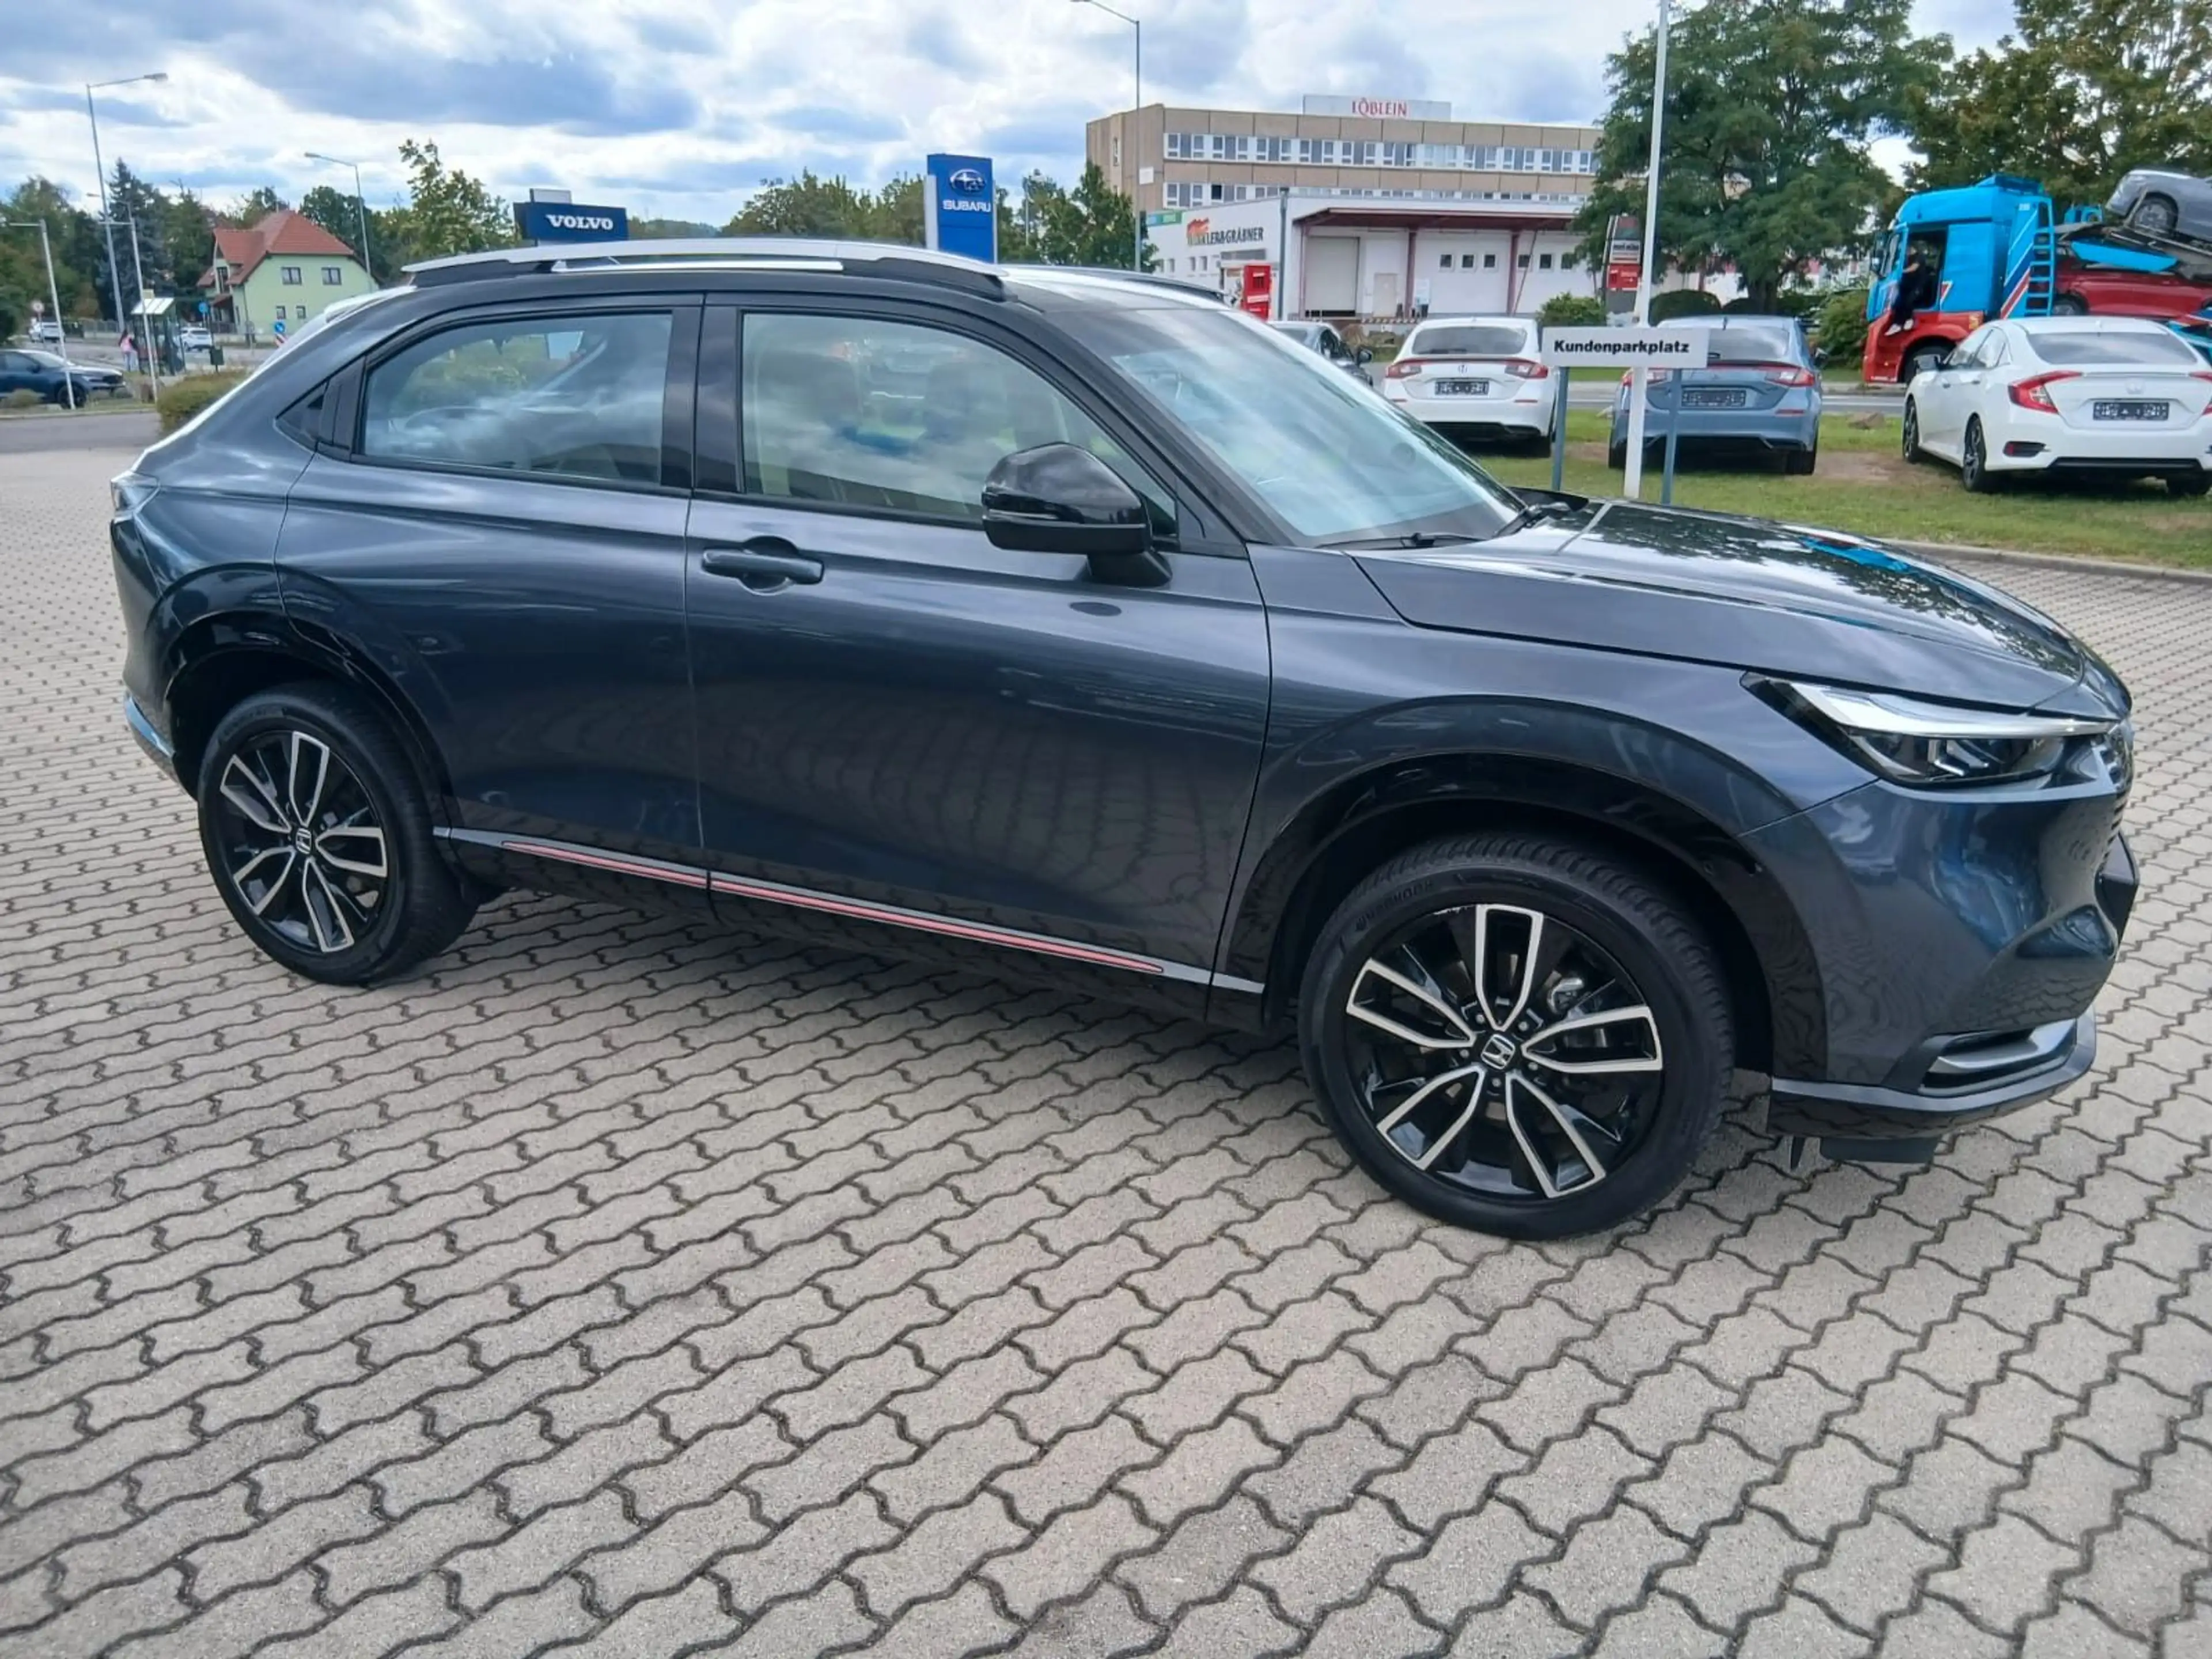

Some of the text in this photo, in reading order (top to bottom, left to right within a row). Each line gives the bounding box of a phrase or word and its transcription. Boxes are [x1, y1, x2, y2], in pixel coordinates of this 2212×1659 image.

[942, 199, 991, 213] SUBARU
[545, 214, 613, 231] VOLVO
[1554, 340, 1690, 356] Kundenparkplatz
